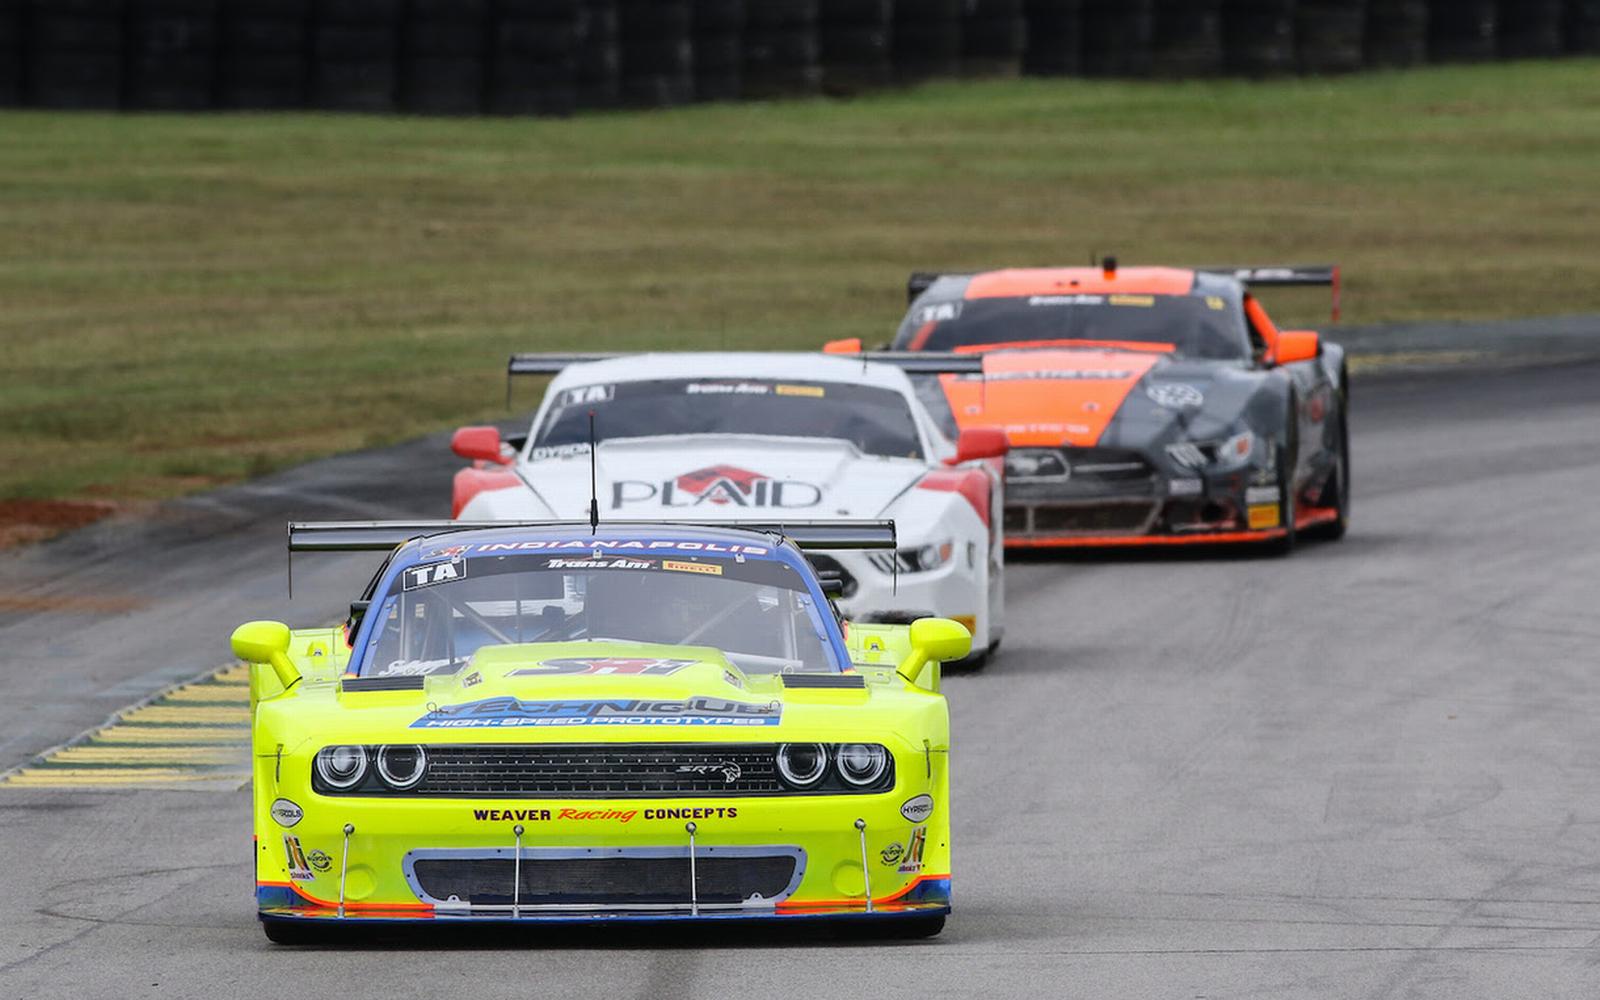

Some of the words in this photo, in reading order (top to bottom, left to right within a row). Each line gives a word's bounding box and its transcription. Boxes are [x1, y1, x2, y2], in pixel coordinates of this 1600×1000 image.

[611, 477, 822, 510] PLAID
[478, 540, 768, 556] INDIANAPOLIS
[547, 559, 608, 569] Trans
[609, 559, 650, 569] Am
[411, 563, 458, 585] TA
[426, 717, 585, 728] HIGH-SPEED
[590, 716, 765, 726] PROTOTYPES
[675, 765, 724, 775] SRT
[473, 809, 551, 821] WEAVER
[557, 807, 638, 823] Racing
[644, 807, 738, 820] CONCEPTS
